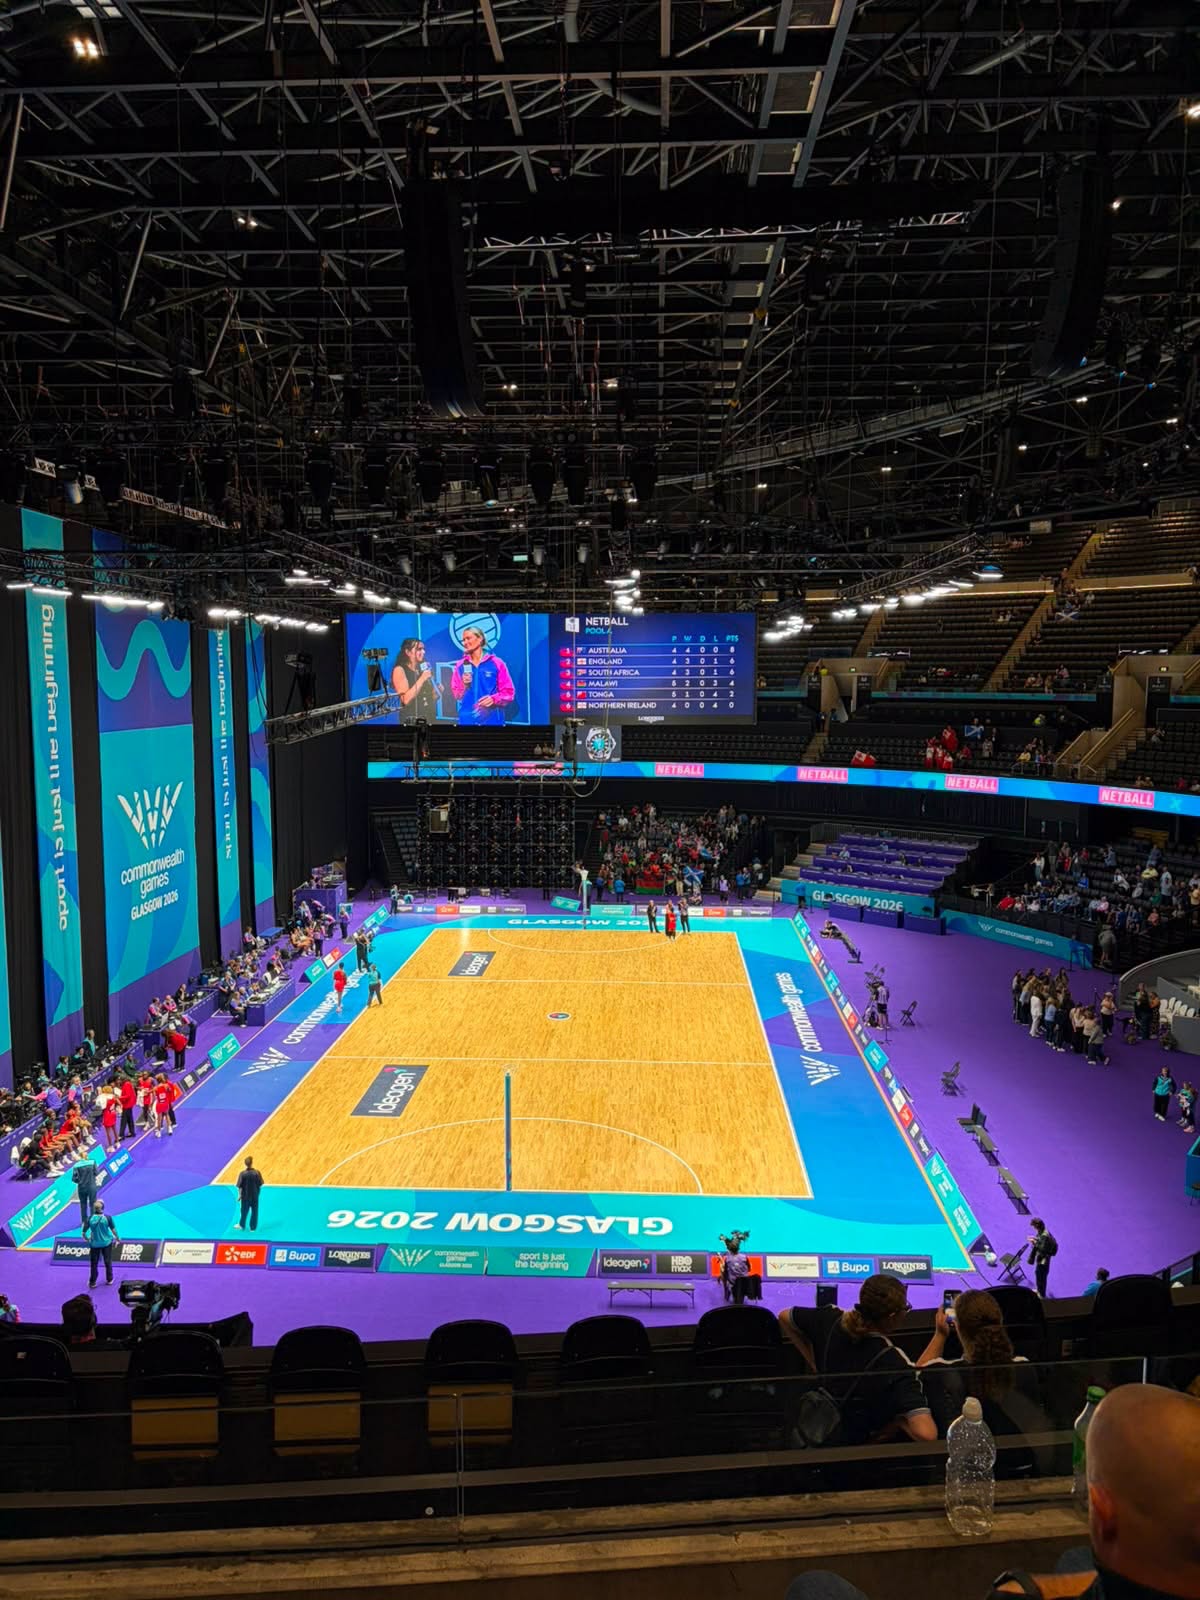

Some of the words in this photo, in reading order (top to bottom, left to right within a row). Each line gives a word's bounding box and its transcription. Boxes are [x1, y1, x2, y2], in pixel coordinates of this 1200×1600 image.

[585, 616, 629, 626] NETBALL
[657, 764, 703, 775] NETBALL
[800, 768, 847, 780] NETBALL
[947, 776, 996, 790] NETBALL
[1101, 789, 1152, 806] NETBALL
[120, 848, 185, 886] commonwealth
[140, 871, 170, 899] games
[131, 894, 162, 921] GLASGOW
[163, 889, 179, 907] 2026
[873, 898, 904, 912] 2026
[282, 987, 350, 1045] commonwea
[781, 994, 823, 1053] commonwealth
[367, 1072, 417, 1114] Ideagen
[326, 1209, 439, 1230] 2026
[445, 1212, 674, 1235] GLASGOW
[122, 1244, 143, 1254] HBO
[288, 1250, 316, 1262] Bupa
[328, 1250, 371, 1260] LONGINES
[520, 1252, 540, 1261] sport
[550, 1252, 566, 1261] just
[603, 1256, 642, 1270] Ideagen
[671, 1256, 692, 1265] HBO
[515, 1260, 528, 1268] the
[530, 1260, 569, 1270] beginning
[841, 1262, 870, 1274] Bupa
[882, 1262, 928, 1270] LONGINES
